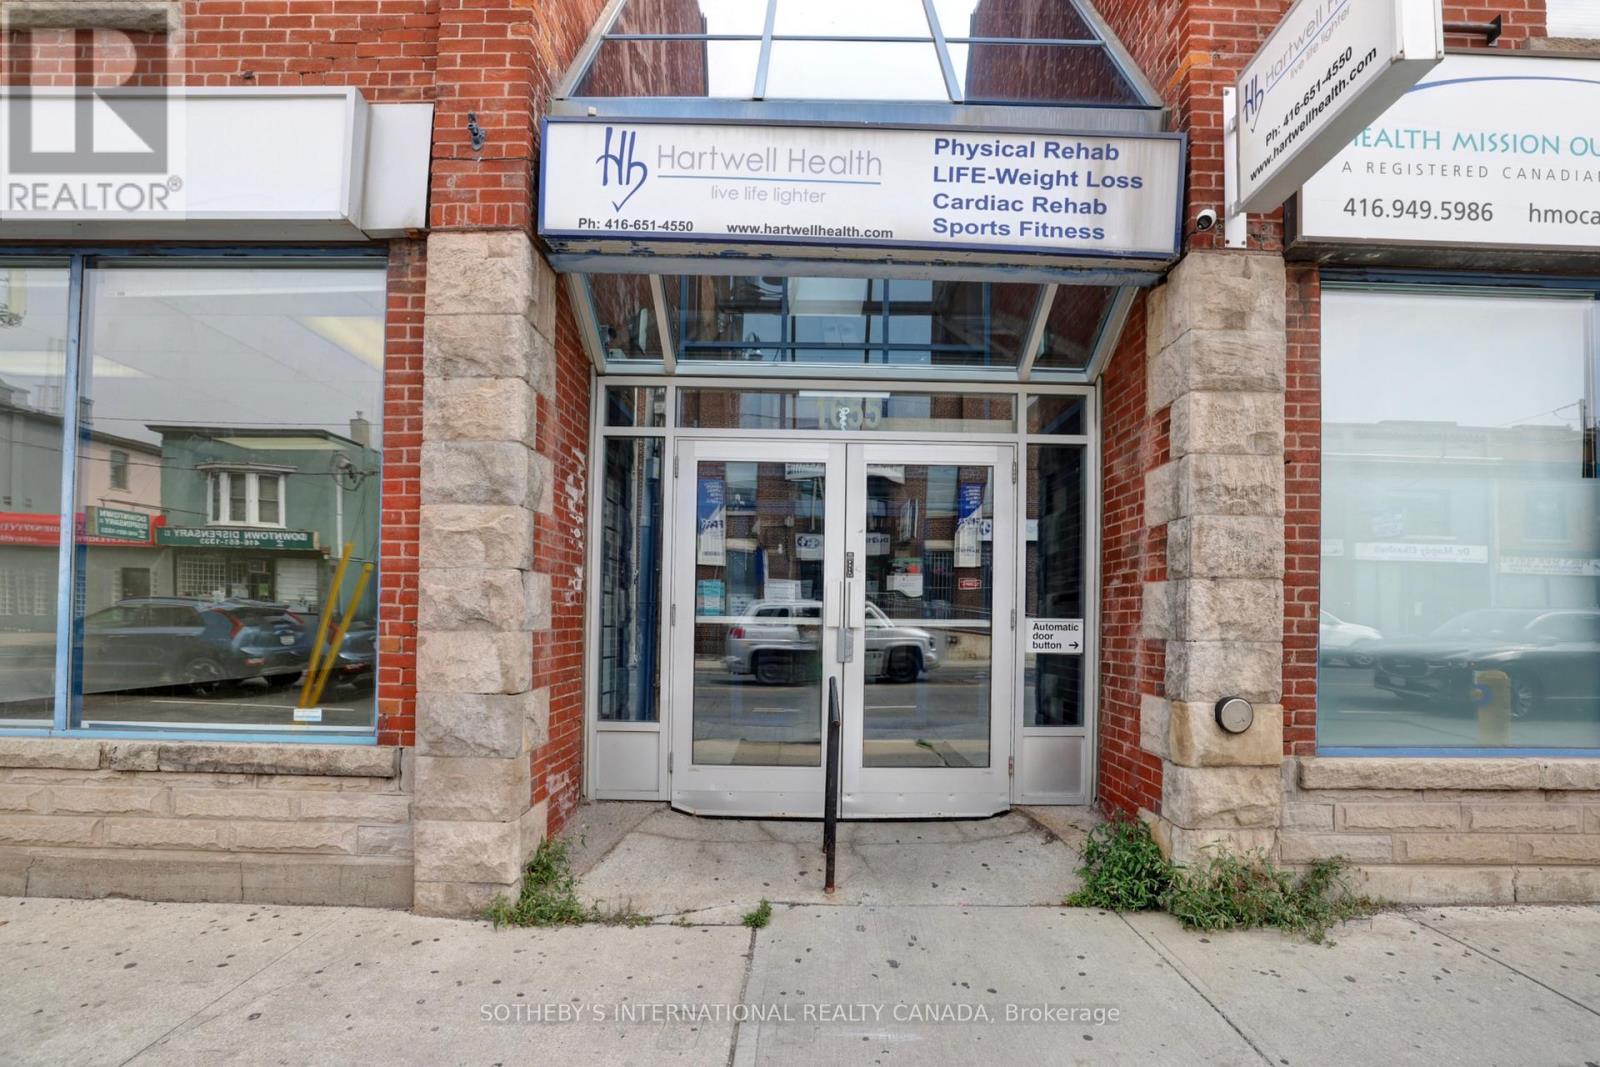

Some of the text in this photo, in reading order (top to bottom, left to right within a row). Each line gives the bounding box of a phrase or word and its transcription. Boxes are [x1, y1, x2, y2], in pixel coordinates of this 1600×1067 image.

[1265, 4, 1323, 88] Hartwell
[1265, 125, 1282, 147] Ph:
[1282, 46, 1353, 127] 416-651-4550
[1249, 47, 1377, 182] www.hartwellhealth.com
[934, 138, 1120, 161] Physical Rehab
[1452, 132, 1560, 155] MISSION
[657, 144, 882, 177] Hartwell Health
[1341, 160, 1600, 183] A REGISTERED CANADIA
[933, 166, 1144, 191] LIFE-Weight Loss
[711, 184, 827, 206] live life lighter
[933, 193, 1108, 215] Cardiac Rehab
[1343, 197, 1494, 222] 416.949.5986
[578, 217, 694, 232] Ph: 416-651-4550
[727, 222, 894, 239] www.hartwellhealth.com
[932, 218, 1106, 240] Sports Fitness
[1032, 623, 1079, 632] Automatic
[1032, 632, 1054, 640] door
[1032, 641, 1062, 649] button
